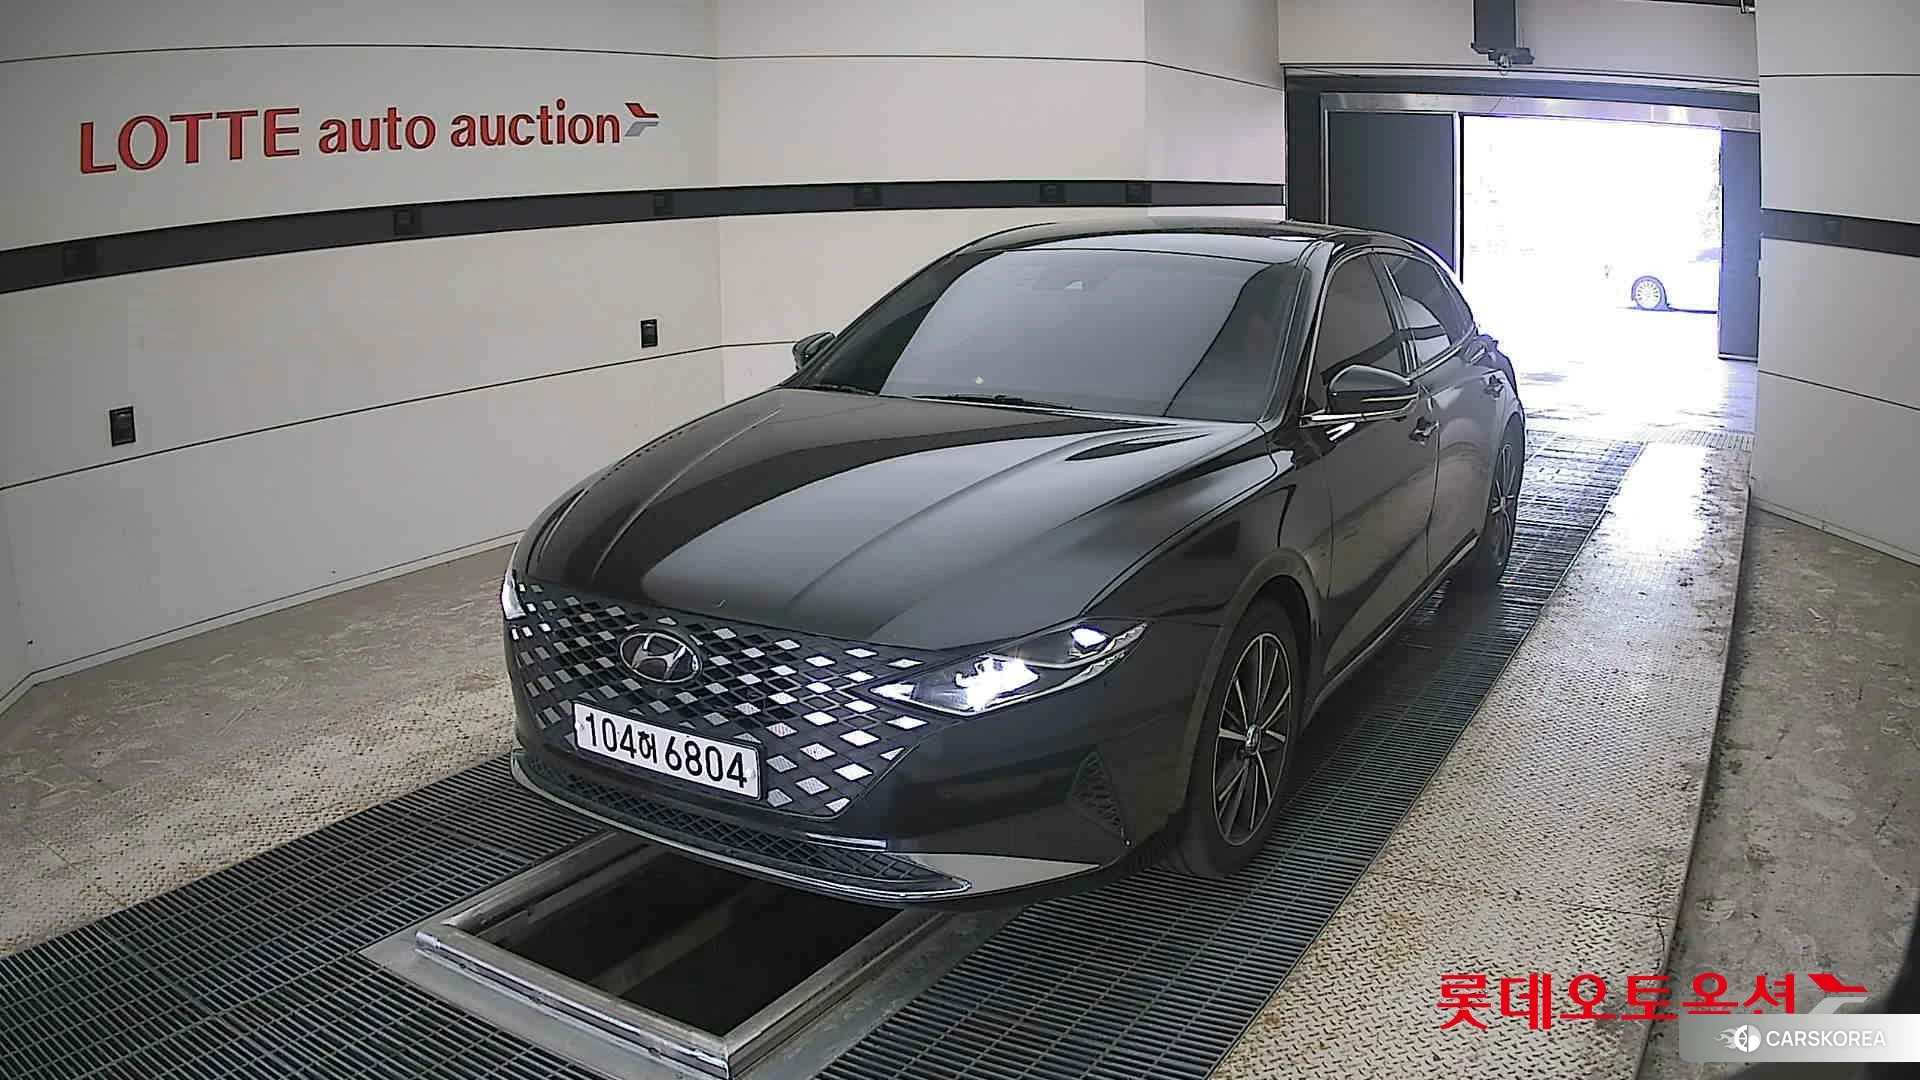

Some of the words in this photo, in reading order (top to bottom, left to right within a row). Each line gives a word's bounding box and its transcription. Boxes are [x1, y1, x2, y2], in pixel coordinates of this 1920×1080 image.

[80, 107, 300, 174] LOTTE
[318, 106, 437, 154] auto
[450, 98, 621, 148] auction
